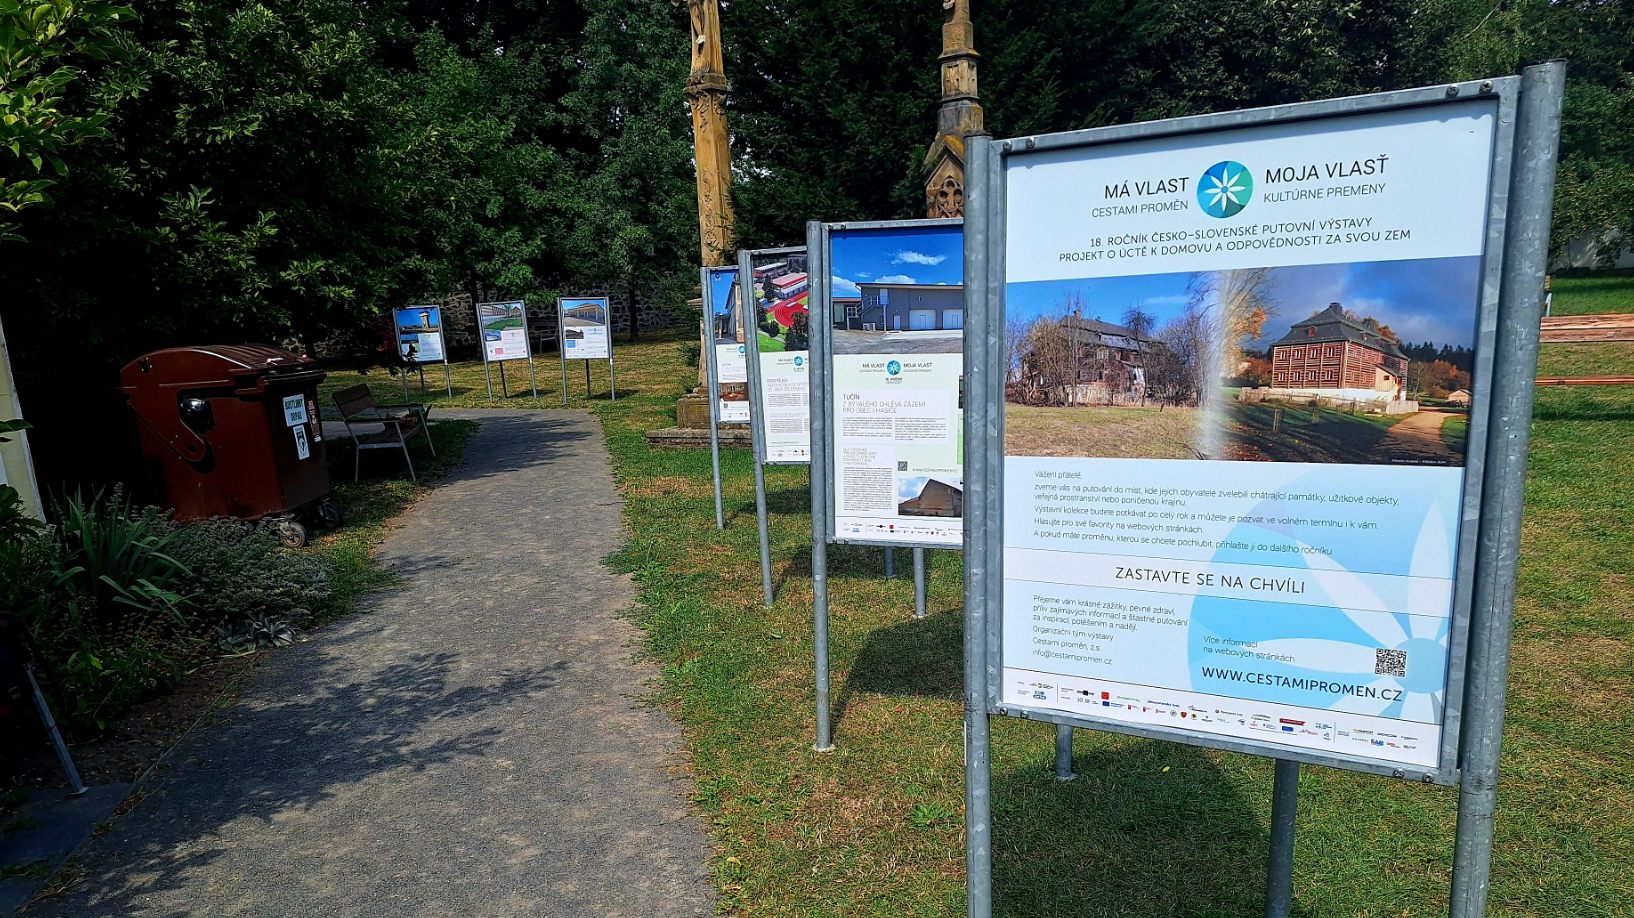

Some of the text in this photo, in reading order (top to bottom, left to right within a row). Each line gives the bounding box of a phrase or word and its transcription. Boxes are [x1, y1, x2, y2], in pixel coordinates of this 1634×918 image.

[1265, 153, 1389, 183] MOJA VLASŤ
[1104, 177, 1190, 198] MÁ VLAST
[1263, 183, 1386, 202] KULTÚRNE PREMENY
[1092, 200, 1188, 217] CESTAMI PROMĚN
[1090, 237, 1104, 247] 18.
[1107, 233, 1148, 245] ROČNÍK
[1262, 220, 1314, 233] PUTOVNÍ
[1319, 216, 1372, 229] VÝSTAVY
[1059, 229, 1410, 261] PROJEKT O ÚCTĚ K DOMOVU A ODPOVĚDNOSTI ZA SVOU ZEM
[1058, 483, 1070, 491] vás
[1113, 485, 1123, 494] do
[1143, 486, 1158, 495] kde
[1158, 488, 1178, 497] jejich
[1179, 488, 1216, 497] obyvatelé
[1249, 491, 1286, 502] chátrající
[1327, 494, 1363, 503] užitkové
[1101, 495, 1119, 503] nebo
[1121, 496, 1159, 505] poničenou
[1034, 505, 1062, 513] Výstavní
[1089, 508, 1114, 516] budete
[1115, 509, 1146, 517] potkávat
[1159, 510, 1174, 520] celý
[1176, 511, 1188, 520] rok
[1196, 512, 1226, 522] můžete
[1227, 515, 1235, 523] je
[1236, 515, 1264, 524] pozvat
[1277, 516, 1308, 526] volném
[1034, 517, 1061, 526] Hlasujte
[1061, 519, 1074, 527] pro
[1088, 520, 1114, 529] favority
[1126, 522, 1163, 531] webových
[1040, 530, 1061, 538] pokud
[1116, 534, 1139, 543] kterou
[1150, 537, 1176, 545] chcete
[1215, 540, 1249, 550] přihlašte
[1256, 543, 1267, 551] do
[1115, 567, 1305, 593] ZASTAVTE SE NA CHVÍLI
[1032, 594, 1060, 604] Přejeme
[1077, 599, 1101, 608] krásné
[1129, 604, 1151, 613] pevné
[1049, 606, 1087, 616] zajímavých
[1088, 610, 1120, 619] informací
[1156, 617, 1188, 626] putování
[1071, 618, 1107, 627] potěšením
[1032, 636, 1059, 646] Cestami
[1087, 632, 1114, 641] výstavy
[1202, 634, 1258, 647] Více informací
[1213, 646, 1254, 658] webových
[1255, 652, 1295, 662] stránkách
[1201, 667, 1402, 700] WWW.CESTAMIPROMEN.CZ
